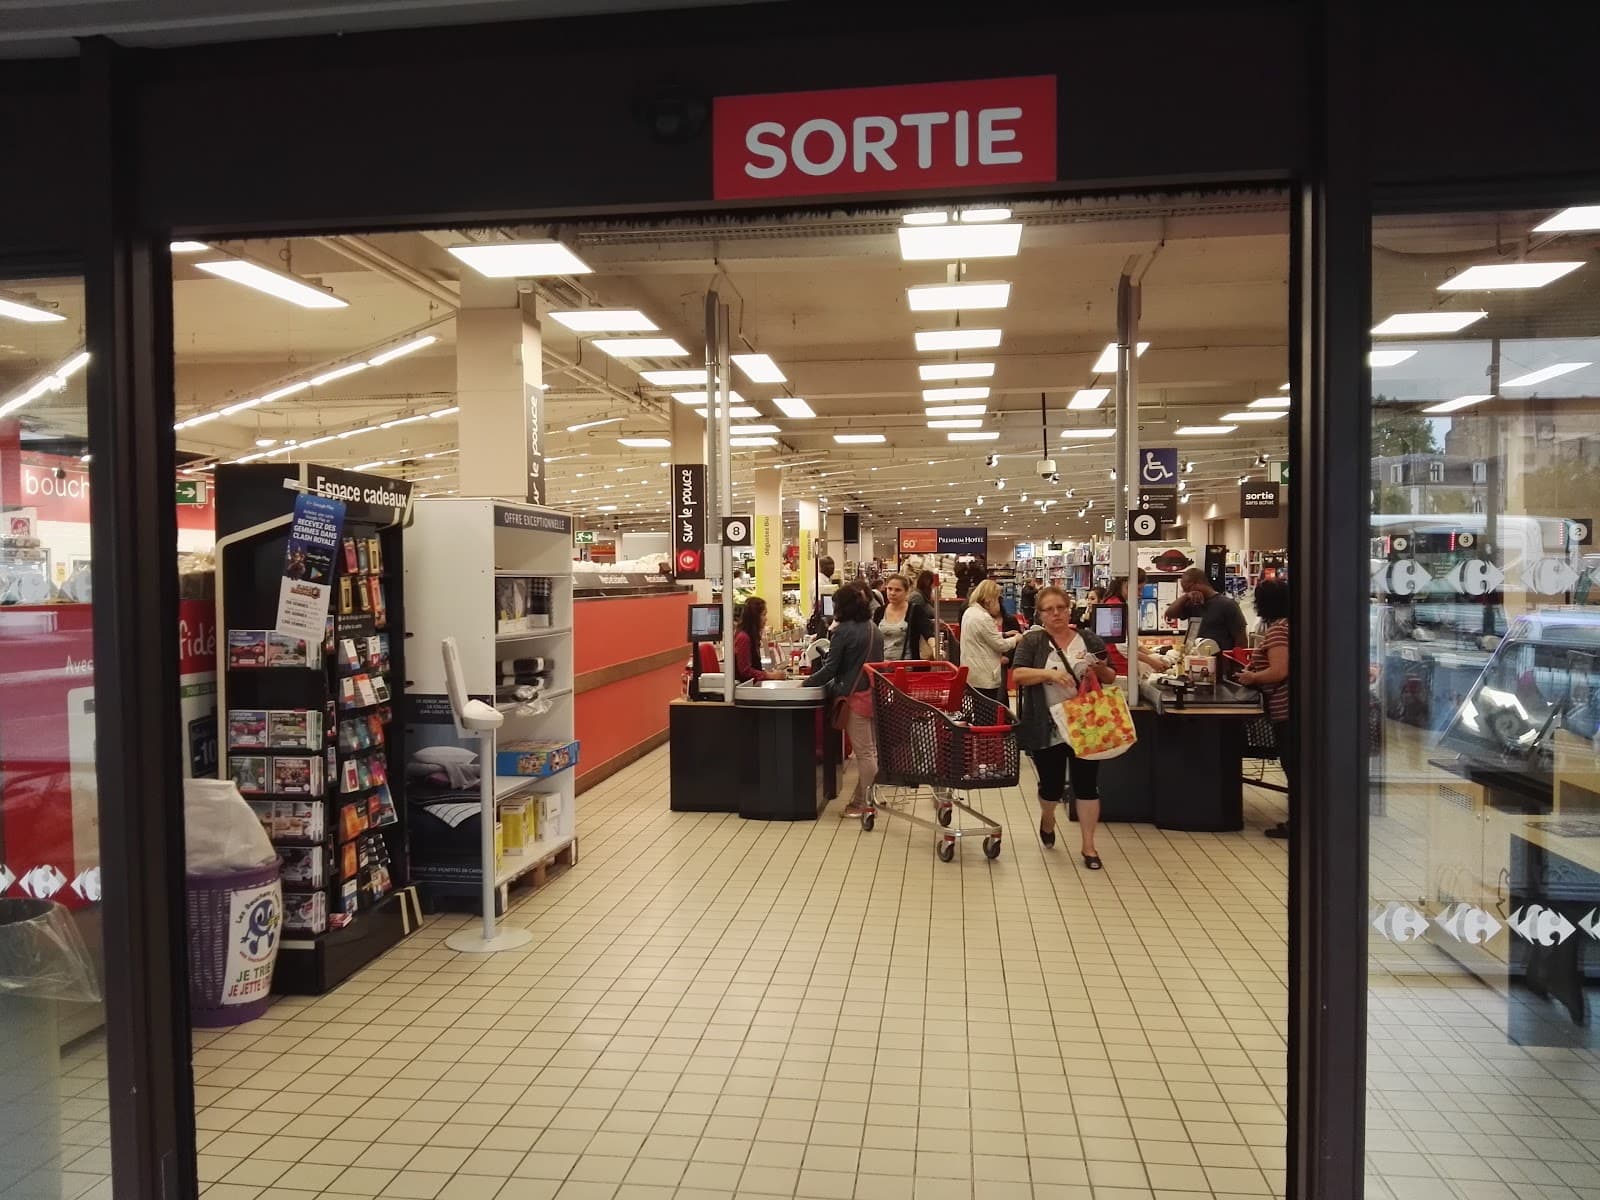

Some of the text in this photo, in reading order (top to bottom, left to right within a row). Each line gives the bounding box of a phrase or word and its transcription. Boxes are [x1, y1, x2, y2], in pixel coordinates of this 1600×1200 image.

[745, 107, 1023, 179] SORTIE
[530, 395, 541, 456] pouce
[316, 476, 406, 508] Espace cadeaux
[1245, 491, 1274, 500] sortie
[677, 469, 698, 543] sur le pouce
[504, 512, 565, 530] OFFRE EXCEPTIONNELLE
[1141, 520, 1149, 529] 6
[733, 526, 740, 536] 8
[236, 969, 250, 983] JE
[228, 984, 239, 998] JE
[239, 980, 261, 996] JETTE
